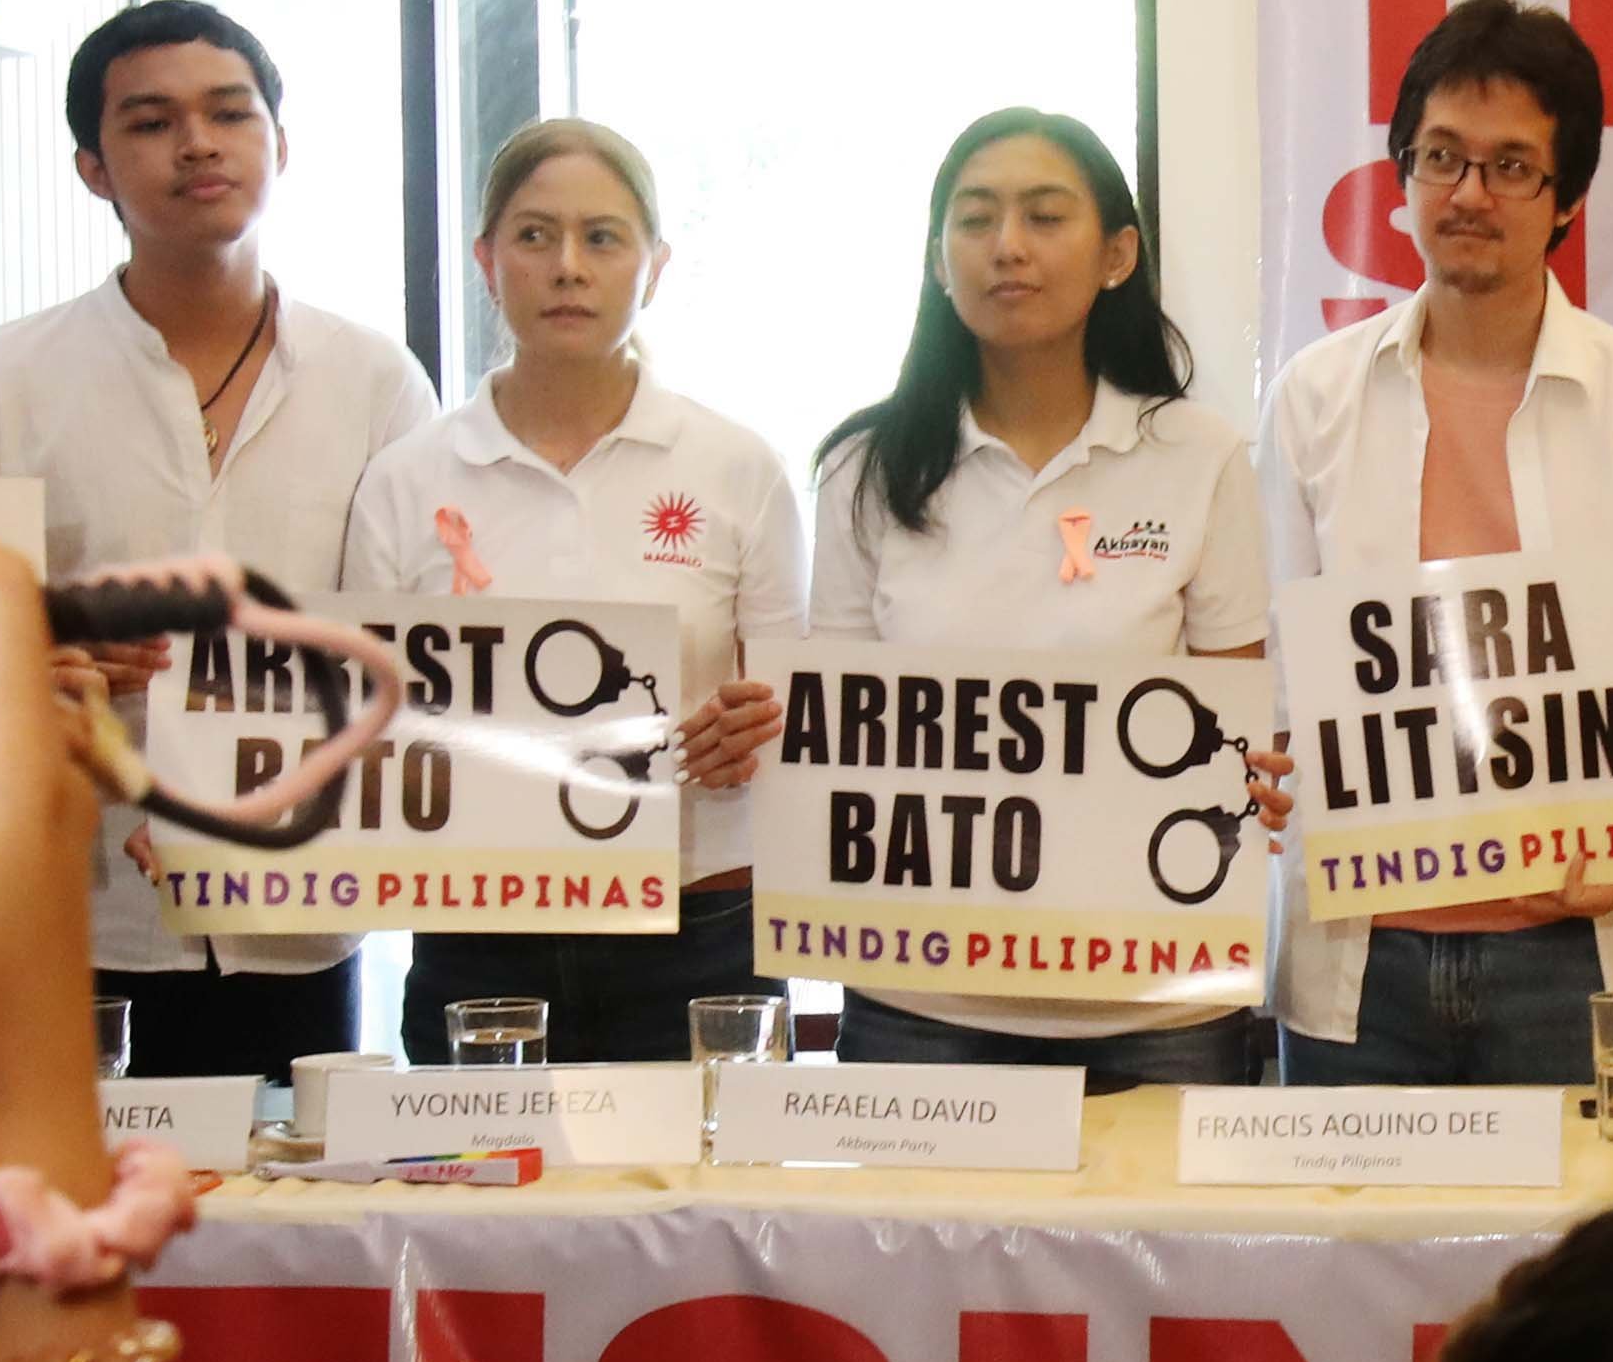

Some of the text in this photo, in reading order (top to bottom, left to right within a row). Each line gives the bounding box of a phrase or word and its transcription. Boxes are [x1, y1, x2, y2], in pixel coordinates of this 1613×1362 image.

[1350, 582, 1575, 695] SARA
[781, 672, 1099, 775] ARREST
[829, 791, 1042, 892] BATO
[1321, 840, 1506, 891] TINDIG
[168, 872, 666, 909] TINDIG PILIPINAS
[770, 918, 1252, 975] TINDIG PILIPINAS
[104, 1105, 174, 1130] NETA
[391, 1092, 510, 1118] YVONNE
[785, 1092, 998, 1125] RAFAELA DAVID
[471, 1133, 535, 1148] Magdalo
[1197, 1110, 1501, 1139] FRANCIS AQUINO DEE
[836, 1136, 936, 1155] Akbayan Party
[1293, 1153, 1402, 1171] Tindig Pilipinas
